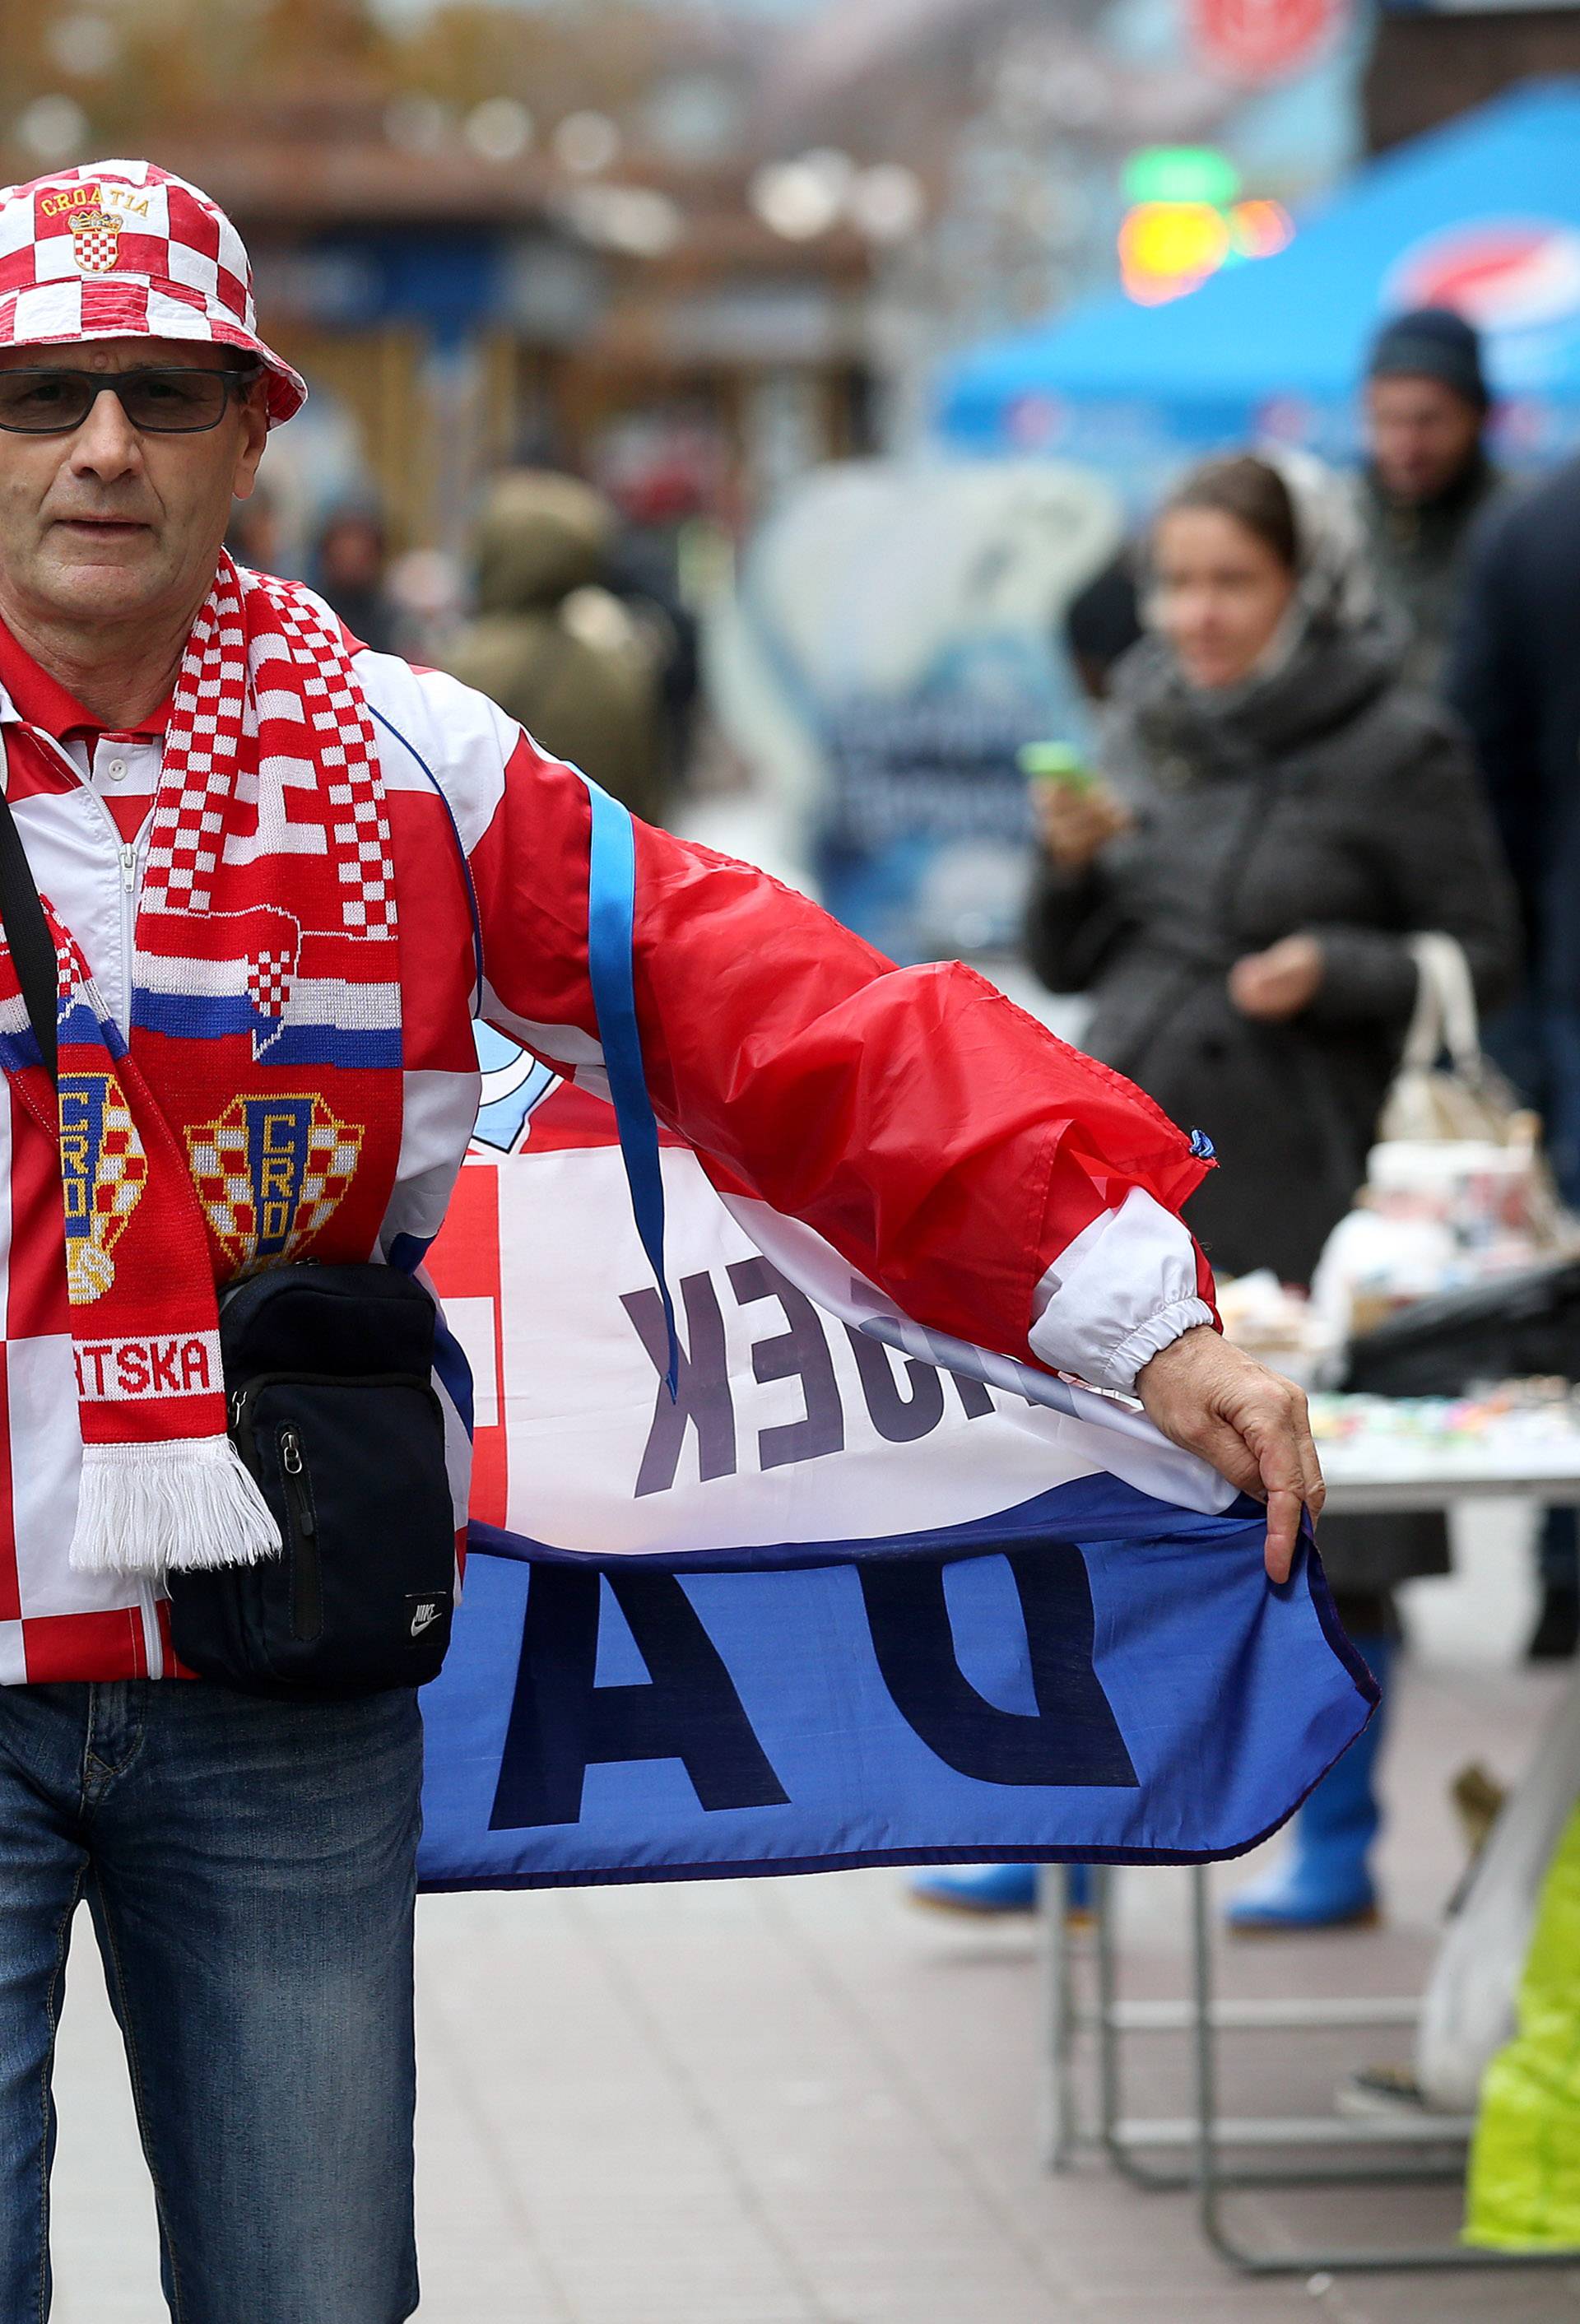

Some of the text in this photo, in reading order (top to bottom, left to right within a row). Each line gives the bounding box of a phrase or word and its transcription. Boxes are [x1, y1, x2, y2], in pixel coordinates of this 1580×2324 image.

[41, 187, 150, 217] CROATIA
[59, 1091, 89, 1218] CRO
[262, 1114, 297, 1239] CRO
[414, 1604, 435, 1622] NIKE
